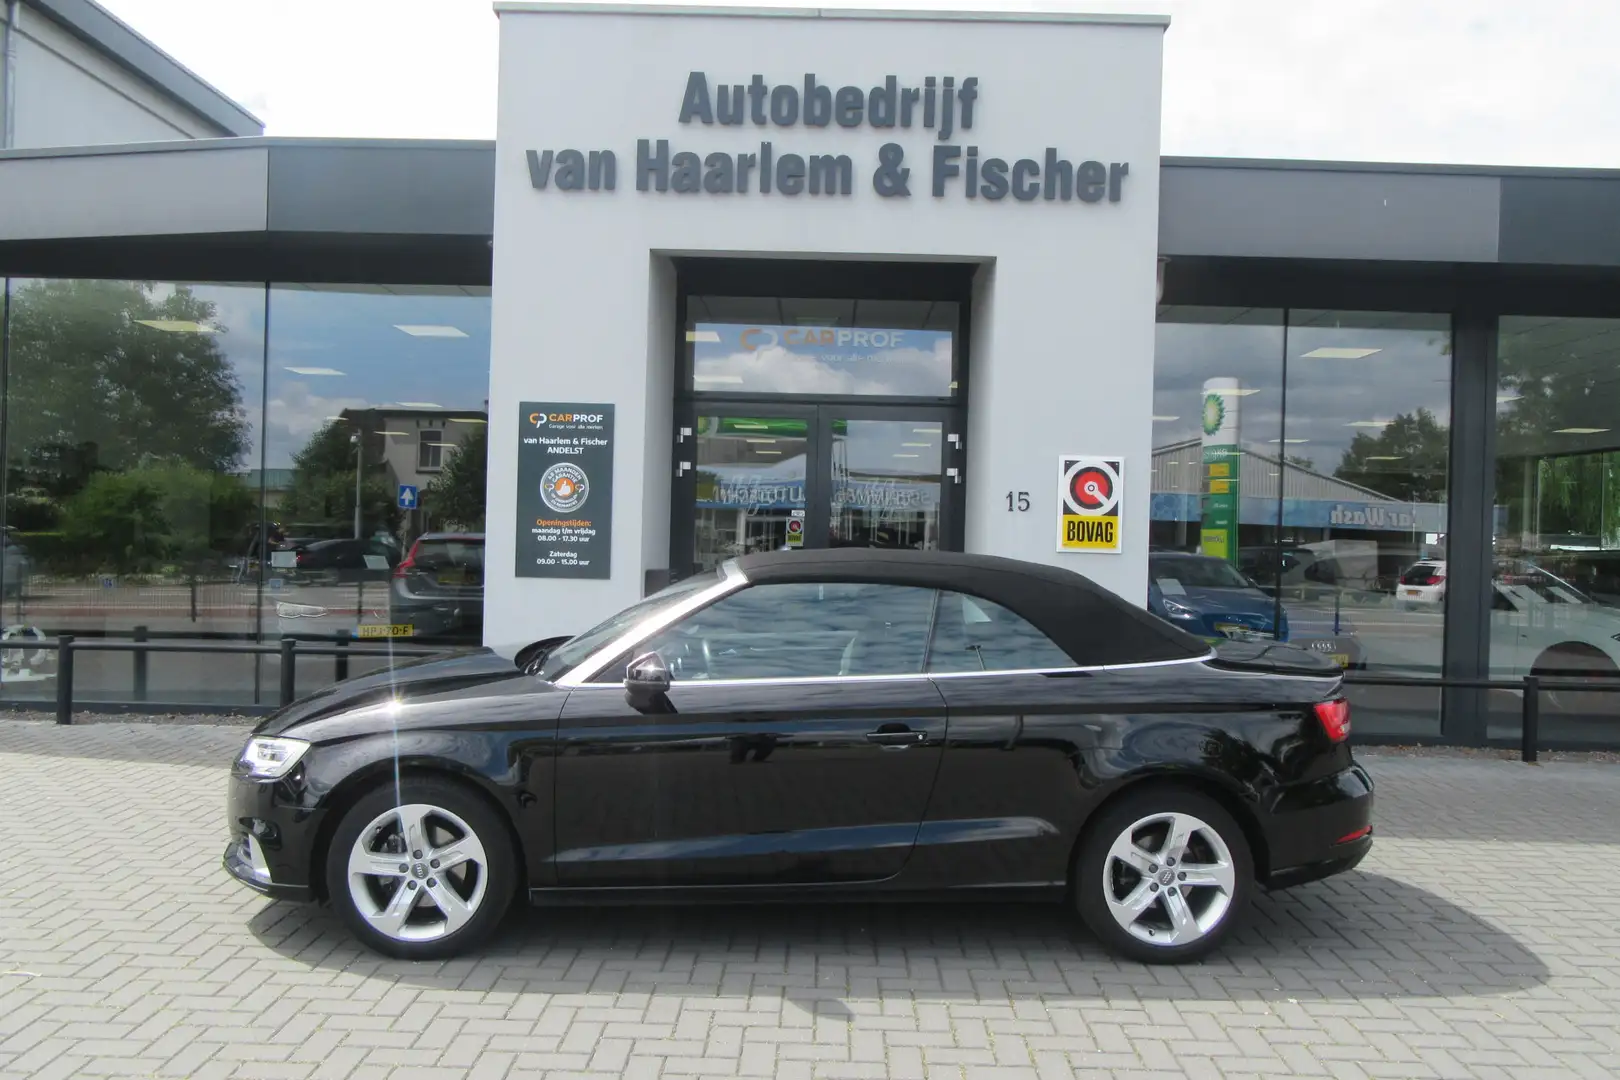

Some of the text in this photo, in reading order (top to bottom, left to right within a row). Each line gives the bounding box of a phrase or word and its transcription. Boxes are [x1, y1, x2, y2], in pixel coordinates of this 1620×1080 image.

[679, 72, 979, 142] Autobedrijf
[526, 139, 1129, 205] van Haarlem & Fischer
[783, 328, 905, 348] CARPROF
[548, 413, 604, 423] CARPROF
[538, 436, 571, 445] Haarlem
[572, 437, 579, 445] &
[580, 437, 608, 446] Fischer
[547, 446, 585, 455] ANDELST
[1005, 491, 1031, 512] 15
[536, 518, 592, 528] Openingstijden:
[531, 527, 561, 535] maandag
[574, 528, 596, 536] vrijdag
[1066, 520, 1114, 543] BOVAG
[549, 550, 577, 559] Zaterdag
